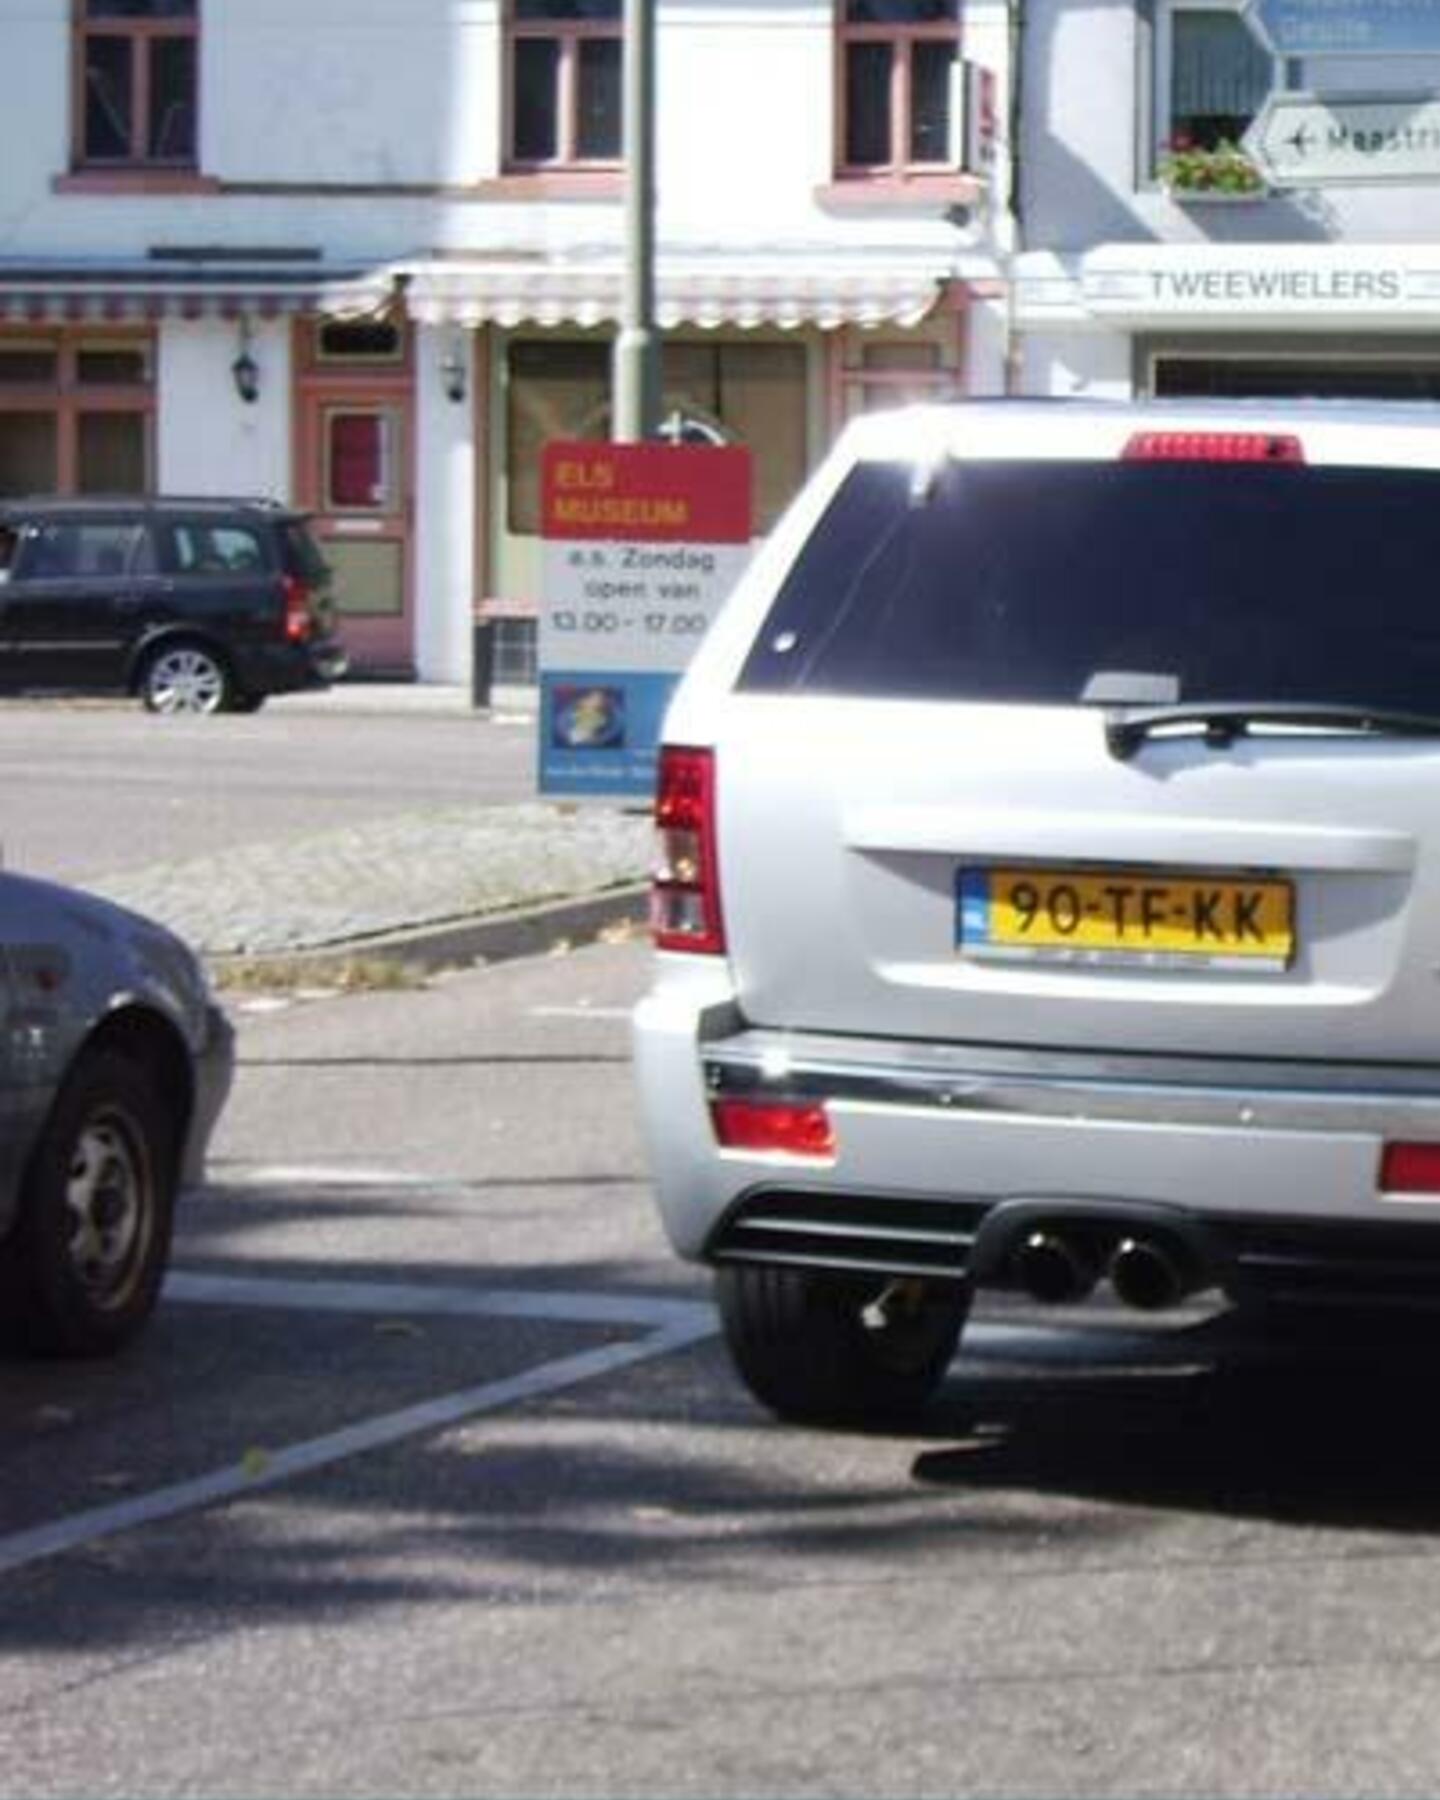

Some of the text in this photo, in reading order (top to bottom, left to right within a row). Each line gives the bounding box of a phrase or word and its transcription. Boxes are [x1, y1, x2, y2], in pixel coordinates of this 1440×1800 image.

[1152, 270, 1398, 299] TWEEWIELERS
[556, 461, 615, 488] ELS
[555, 496, 688, 524] MUSEUM
[622, 548, 715, 571] Zondag
[585, 582, 700, 600] open van
[1010, 882, 1266, 941] 90-TF-KK
